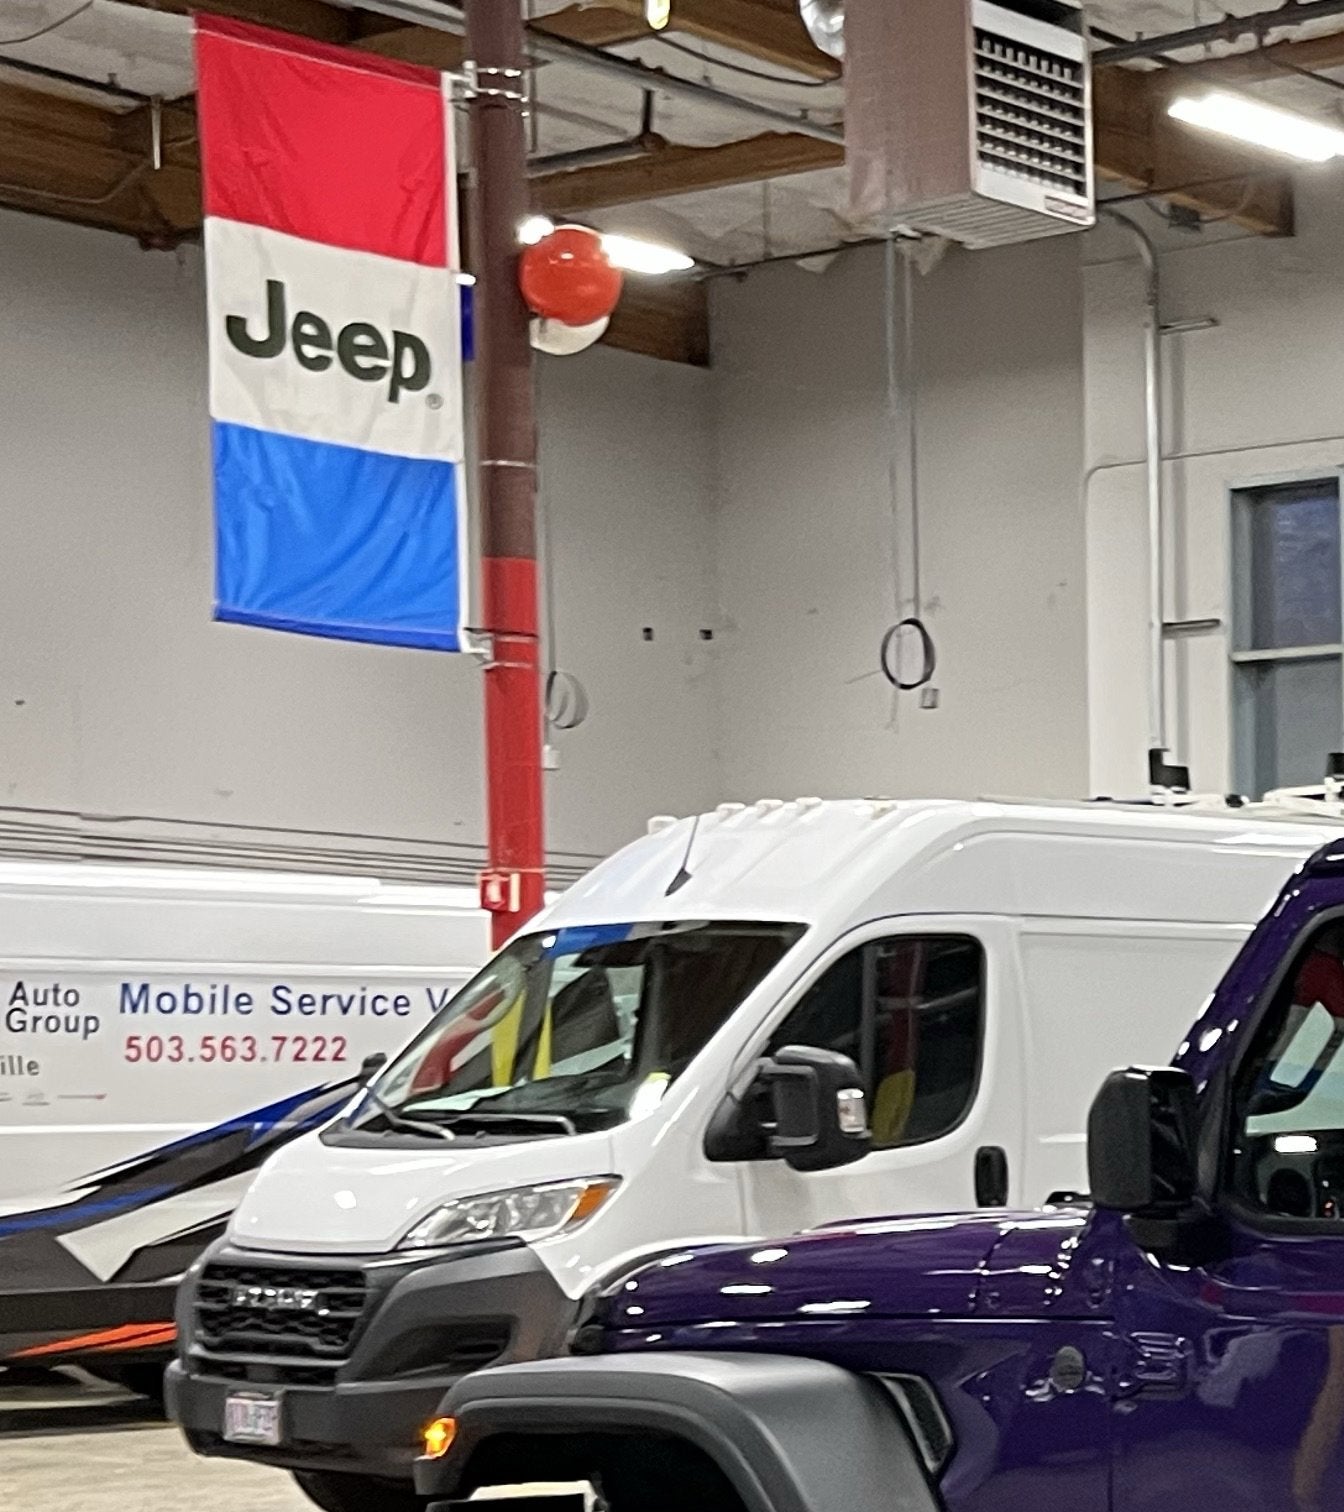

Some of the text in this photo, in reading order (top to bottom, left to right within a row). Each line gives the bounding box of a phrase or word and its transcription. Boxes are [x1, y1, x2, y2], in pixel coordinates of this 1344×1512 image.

[225, 279, 432, 405] Jeep
[9, 981, 80, 1008] Auto
[118, 982, 254, 1017] Mobile
[270, 984, 411, 1017] Service
[5, 1008, 100, 1041] Group
[124, 1036, 347, 1063] 503.563.7222
